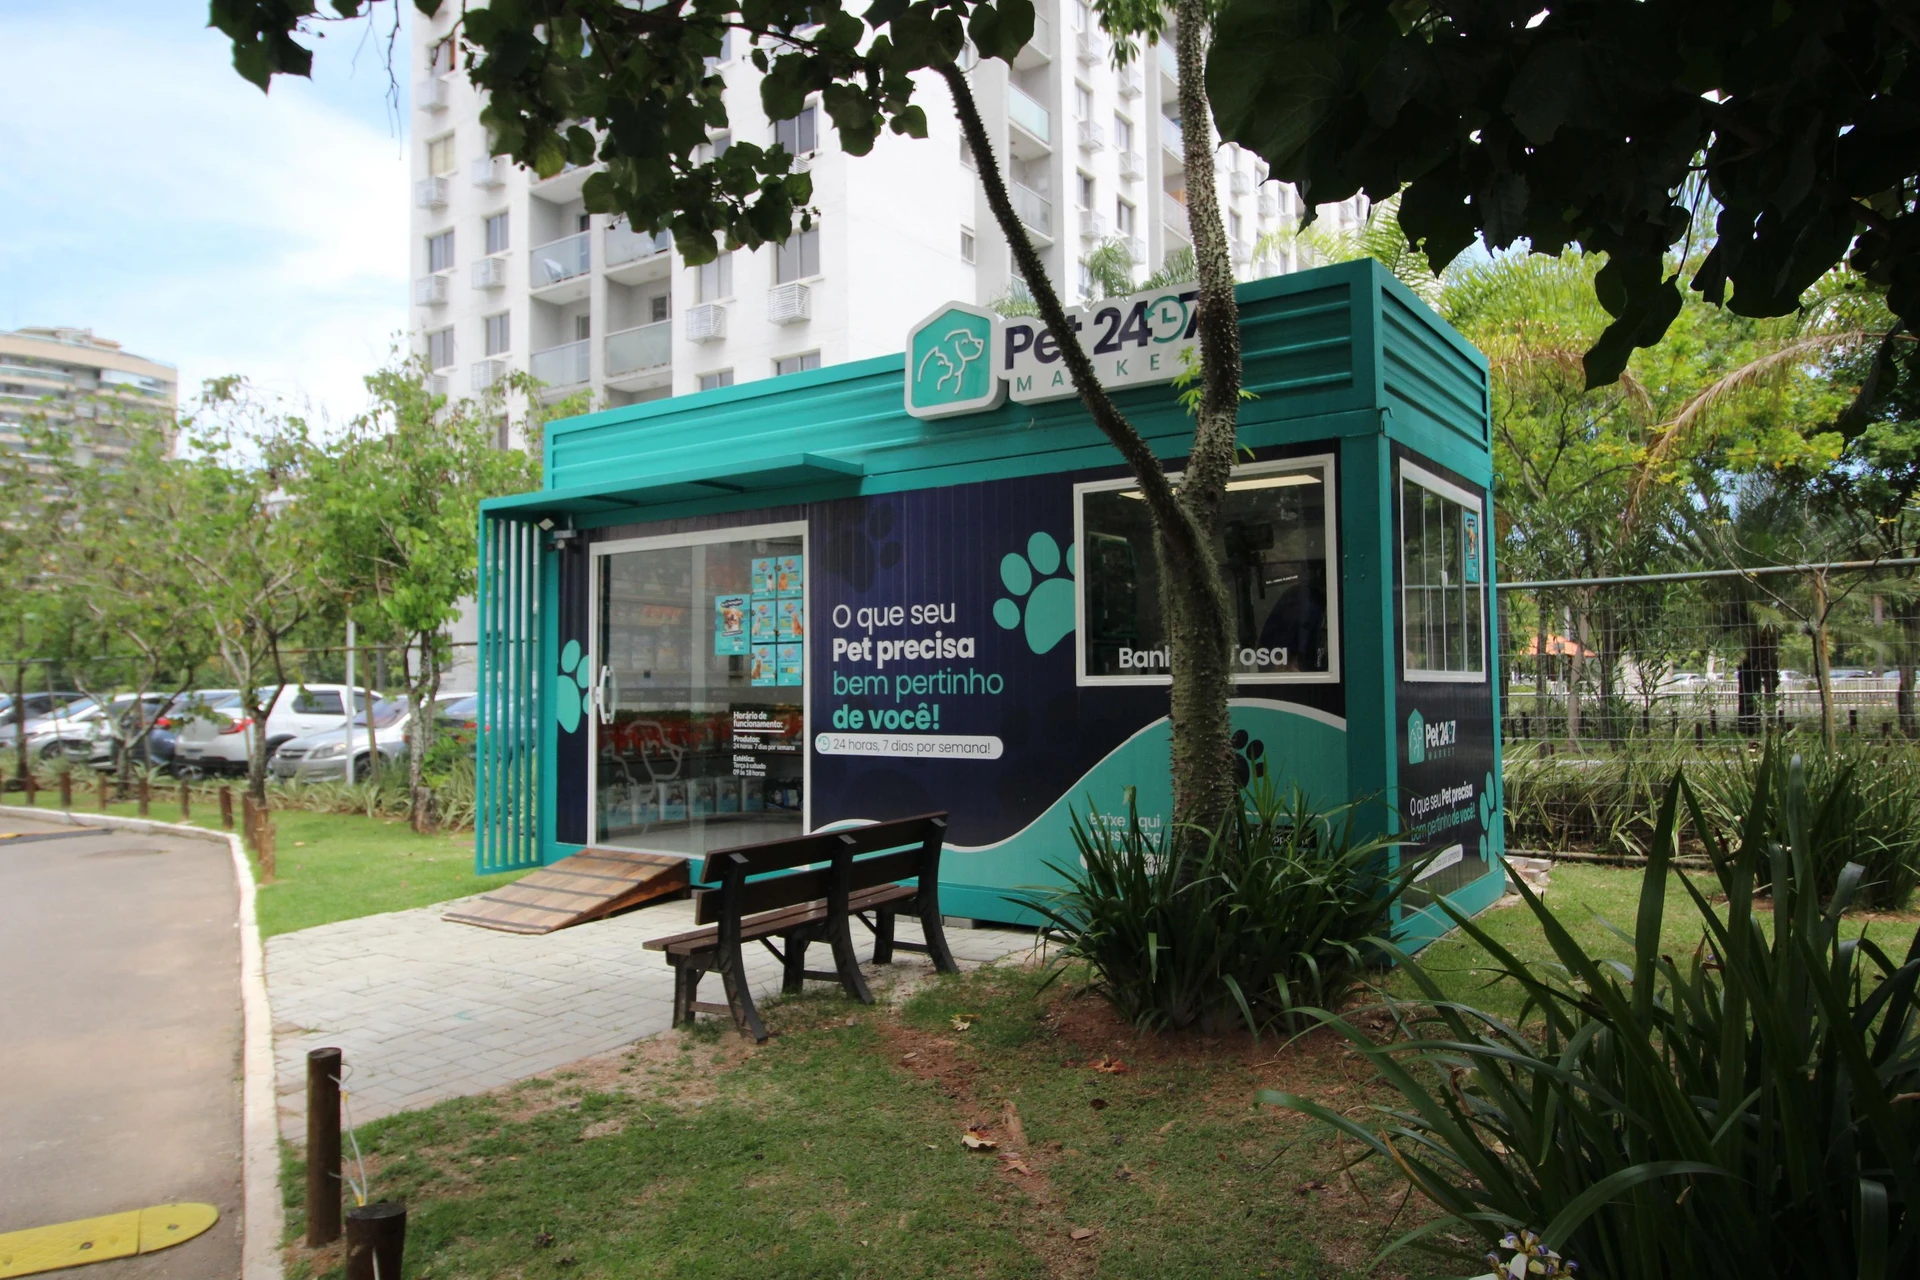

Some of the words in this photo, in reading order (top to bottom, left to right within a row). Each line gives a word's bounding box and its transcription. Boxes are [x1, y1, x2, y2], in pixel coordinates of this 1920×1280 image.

[1016, 346, 1194, 394] MAKE
[832, 604, 851, 629] O
[857, 605, 904, 635] que
[910, 602, 956, 625] seu
[832, 637, 872, 662] Pet
[877, 630, 975, 669] precisa
[1118, 643, 1171, 669] Ban
[833, 670, 888, 695] bem
[896, 667, 1004, 703] pertinho
[733, 711, 758, 720] Horário
[758, 711, 768, 720] de
[733, 719, 784, 728] funcionamento:
[832, 704, 864, 730] de
[868, 702, 940, 730] você!
[833, 738, 846, 750] 24
[883, 739, 889, 750] 7
[891, 740, 914, 752] dias
[917, 742, 936, 755] por
[938, 742, 991, 754] semana!
[1425, 722, 1439, 749] Pet
[1410, 797, 1416, 816] O
[1417, 796, 1430, 819] que
[1430, 792, 1441, 810] seu
[1441, 786, 1451, 806] Pet
[1452, 780, 1473, 809] precisa
[1137, 814, 1161, 832] qui
[1427, 811, 1451, 843] pertinho
[1451, 808, 1460, 826] de
[1134, 832, 1162, 848] pp
